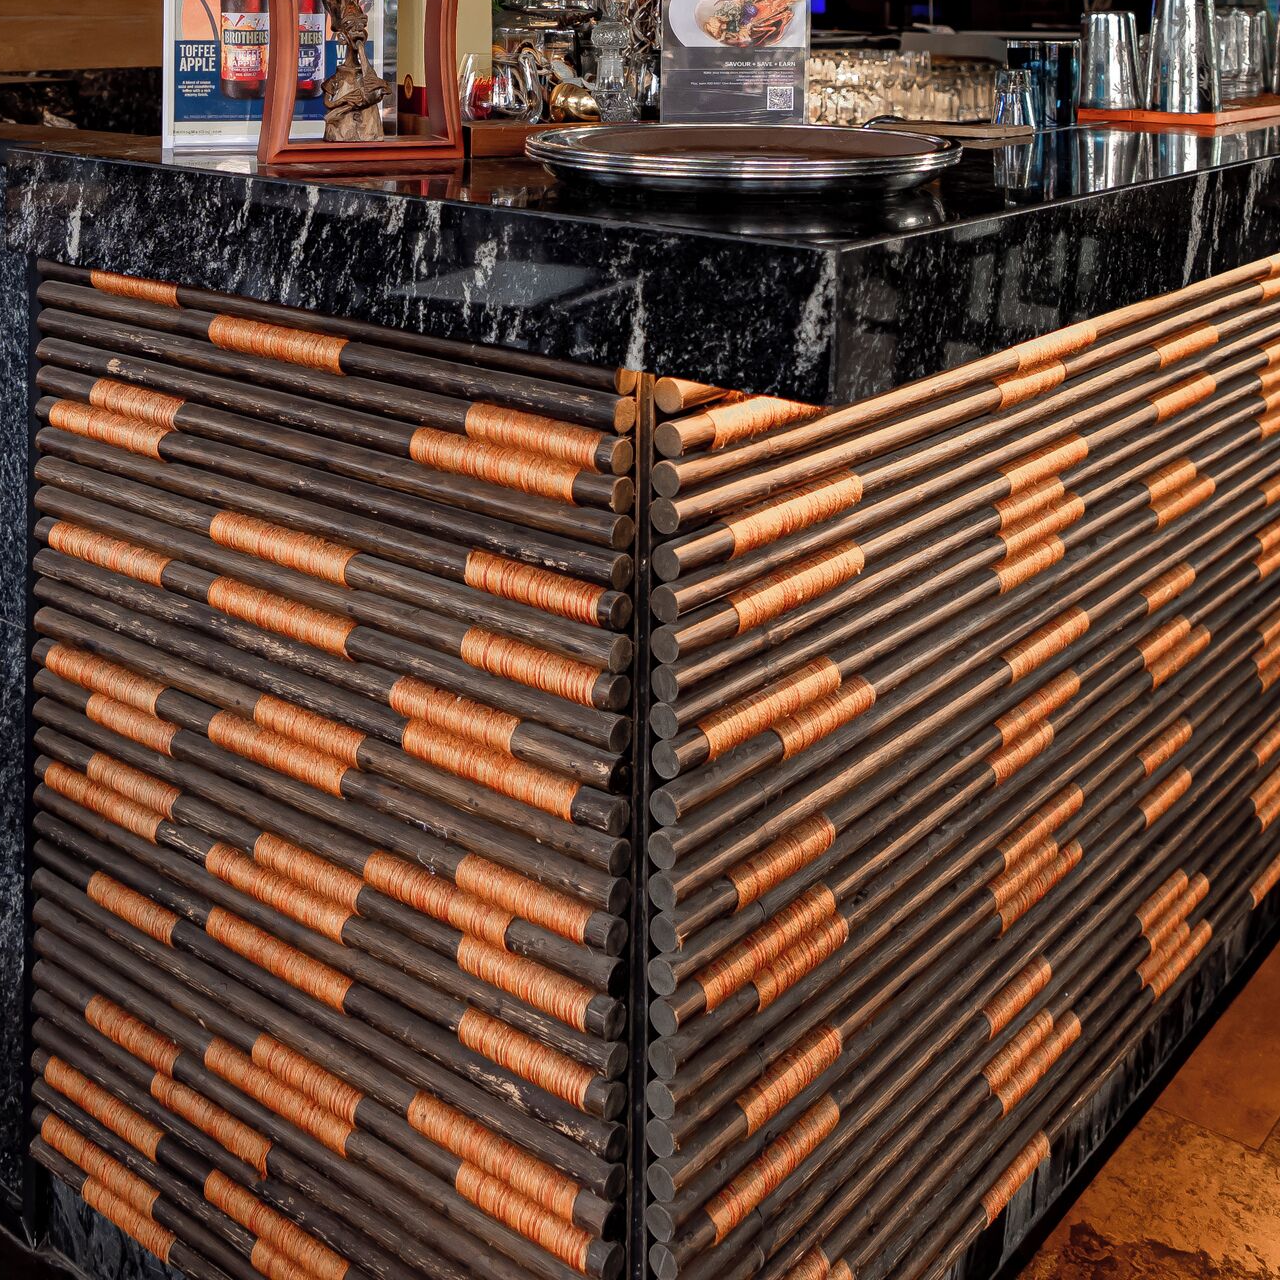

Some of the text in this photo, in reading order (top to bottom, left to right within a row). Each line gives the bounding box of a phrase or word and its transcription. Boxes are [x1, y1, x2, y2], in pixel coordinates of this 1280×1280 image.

[224, 31, 269, 45] BROTHERS
[179, 44, 216, 57] TOFFEE
[179, 57, 216, 71] APPLE
